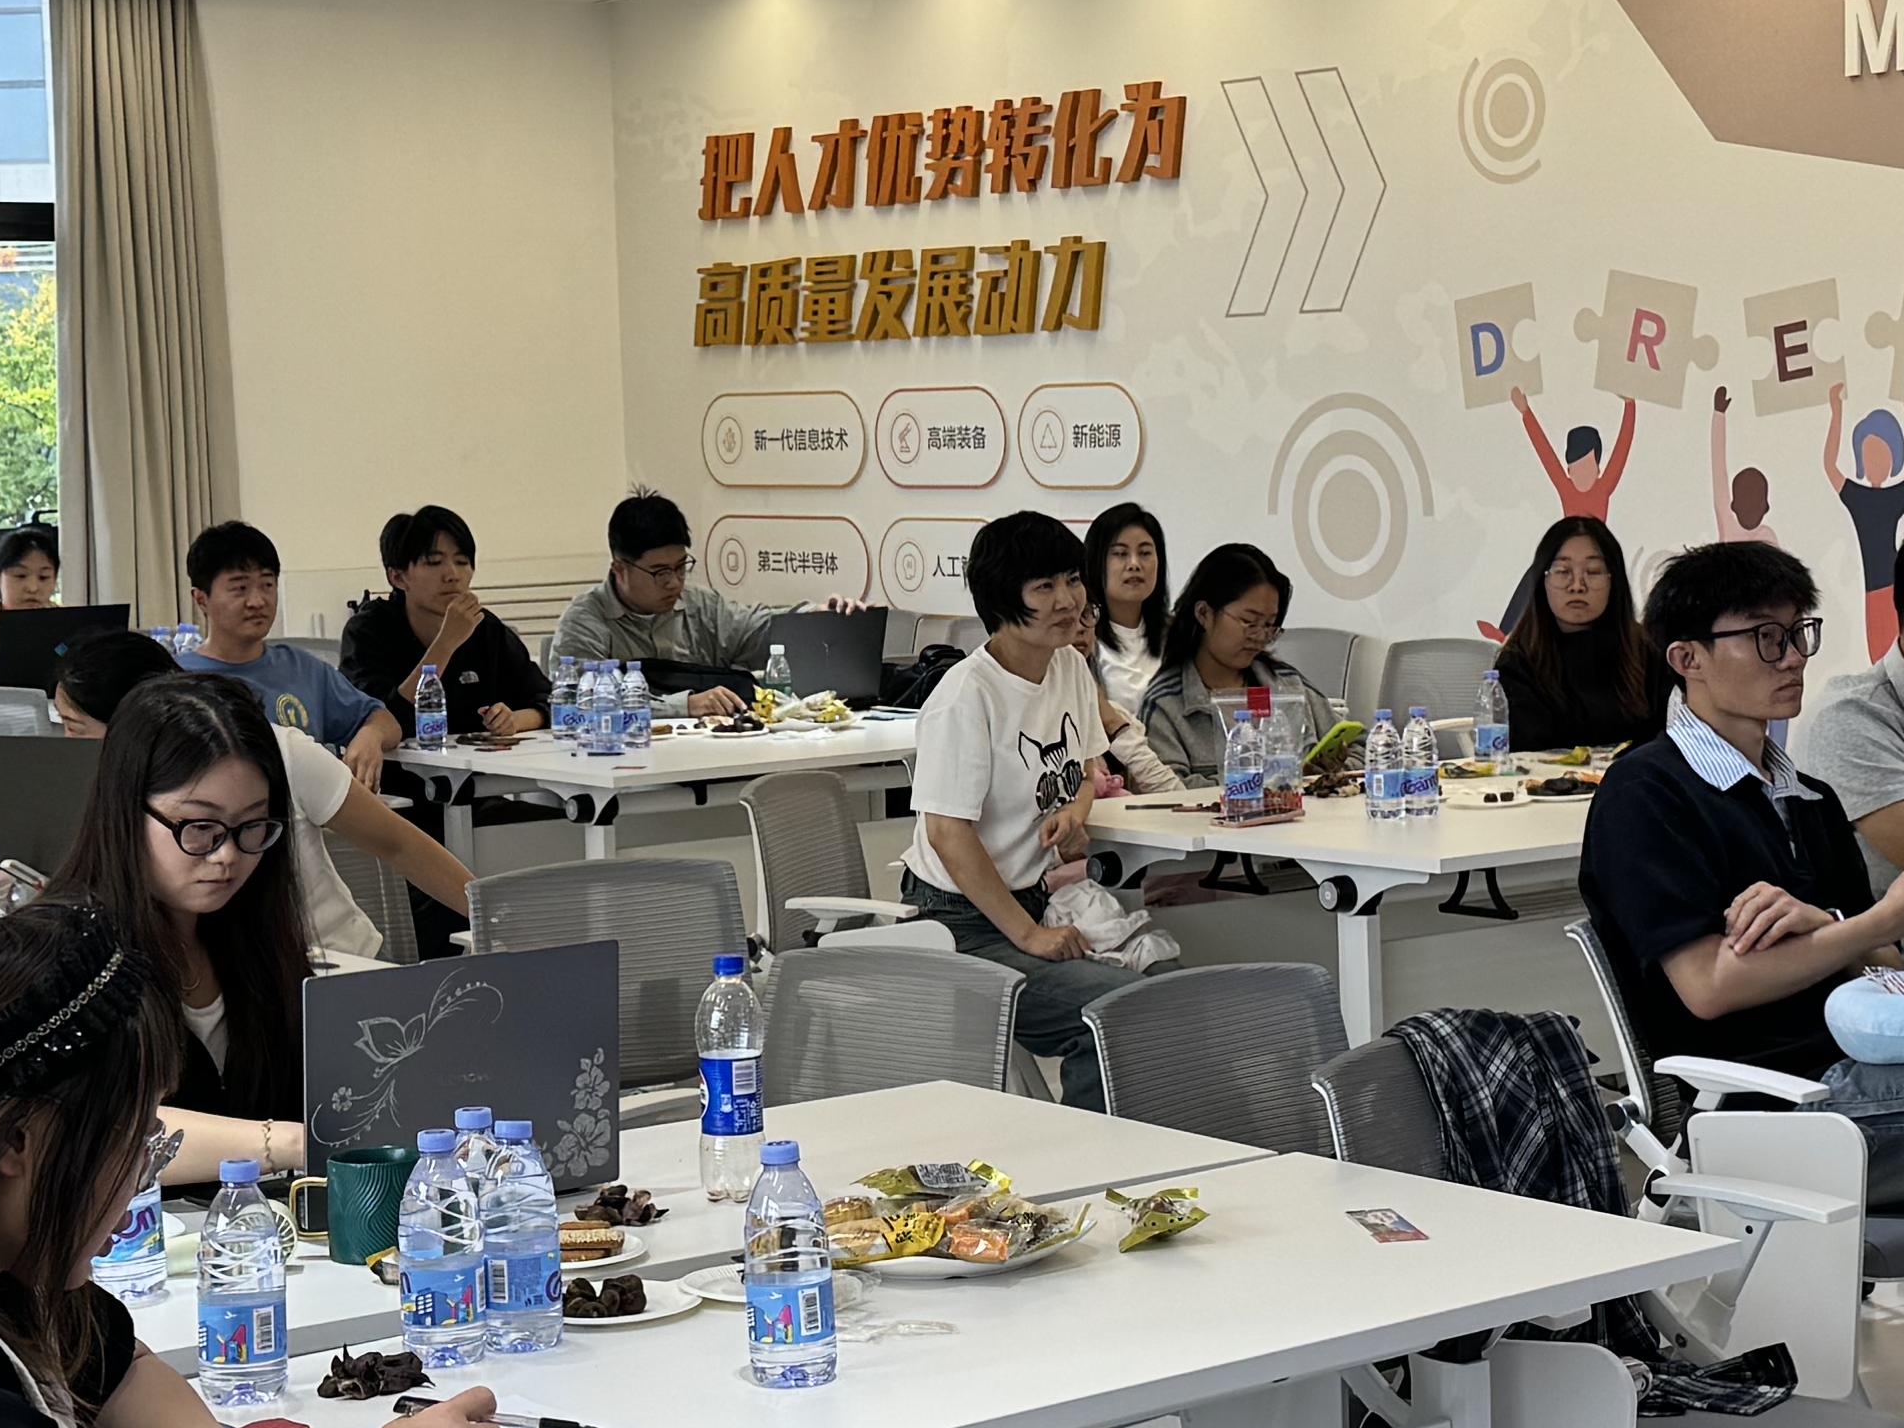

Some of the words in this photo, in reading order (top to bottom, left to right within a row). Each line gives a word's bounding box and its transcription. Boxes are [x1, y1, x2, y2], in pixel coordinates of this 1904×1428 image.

[698, 80, 1187, 221] 把人才优势转化为
[694, 236, 1107, 347] 高质量发展动力
[754, 428, 848, 452] 新一代信息技术
[927, 425, 986, 451] 高端装备
[1072, 424, 1121, 449] 新能源
[757, 550, 838, 575] 第三代半导体
